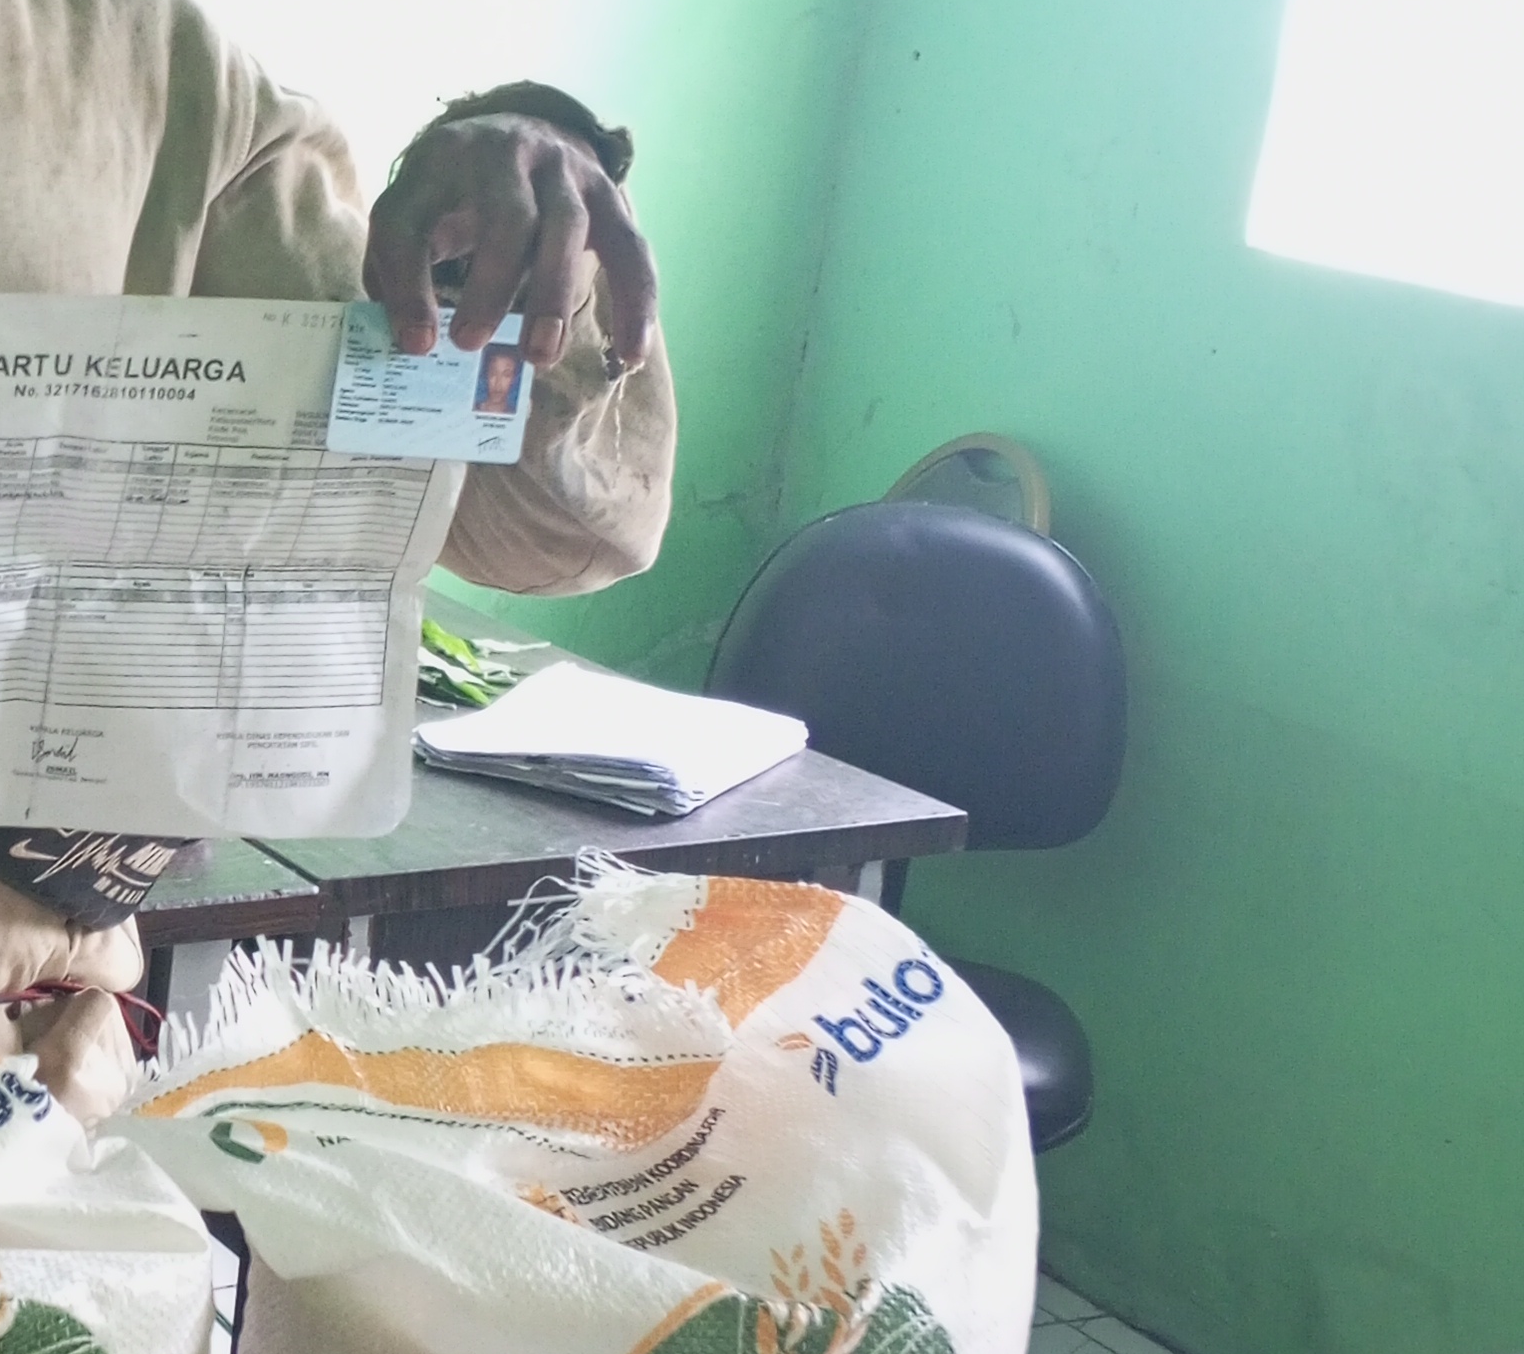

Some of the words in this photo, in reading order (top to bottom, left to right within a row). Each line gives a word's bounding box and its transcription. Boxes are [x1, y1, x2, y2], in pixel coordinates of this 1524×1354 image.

[84, 355, 247, 383] KELUARGA
[810, 957, 944, 1064] bulo
[679, 1173, 748, 1231] INDONESIA
